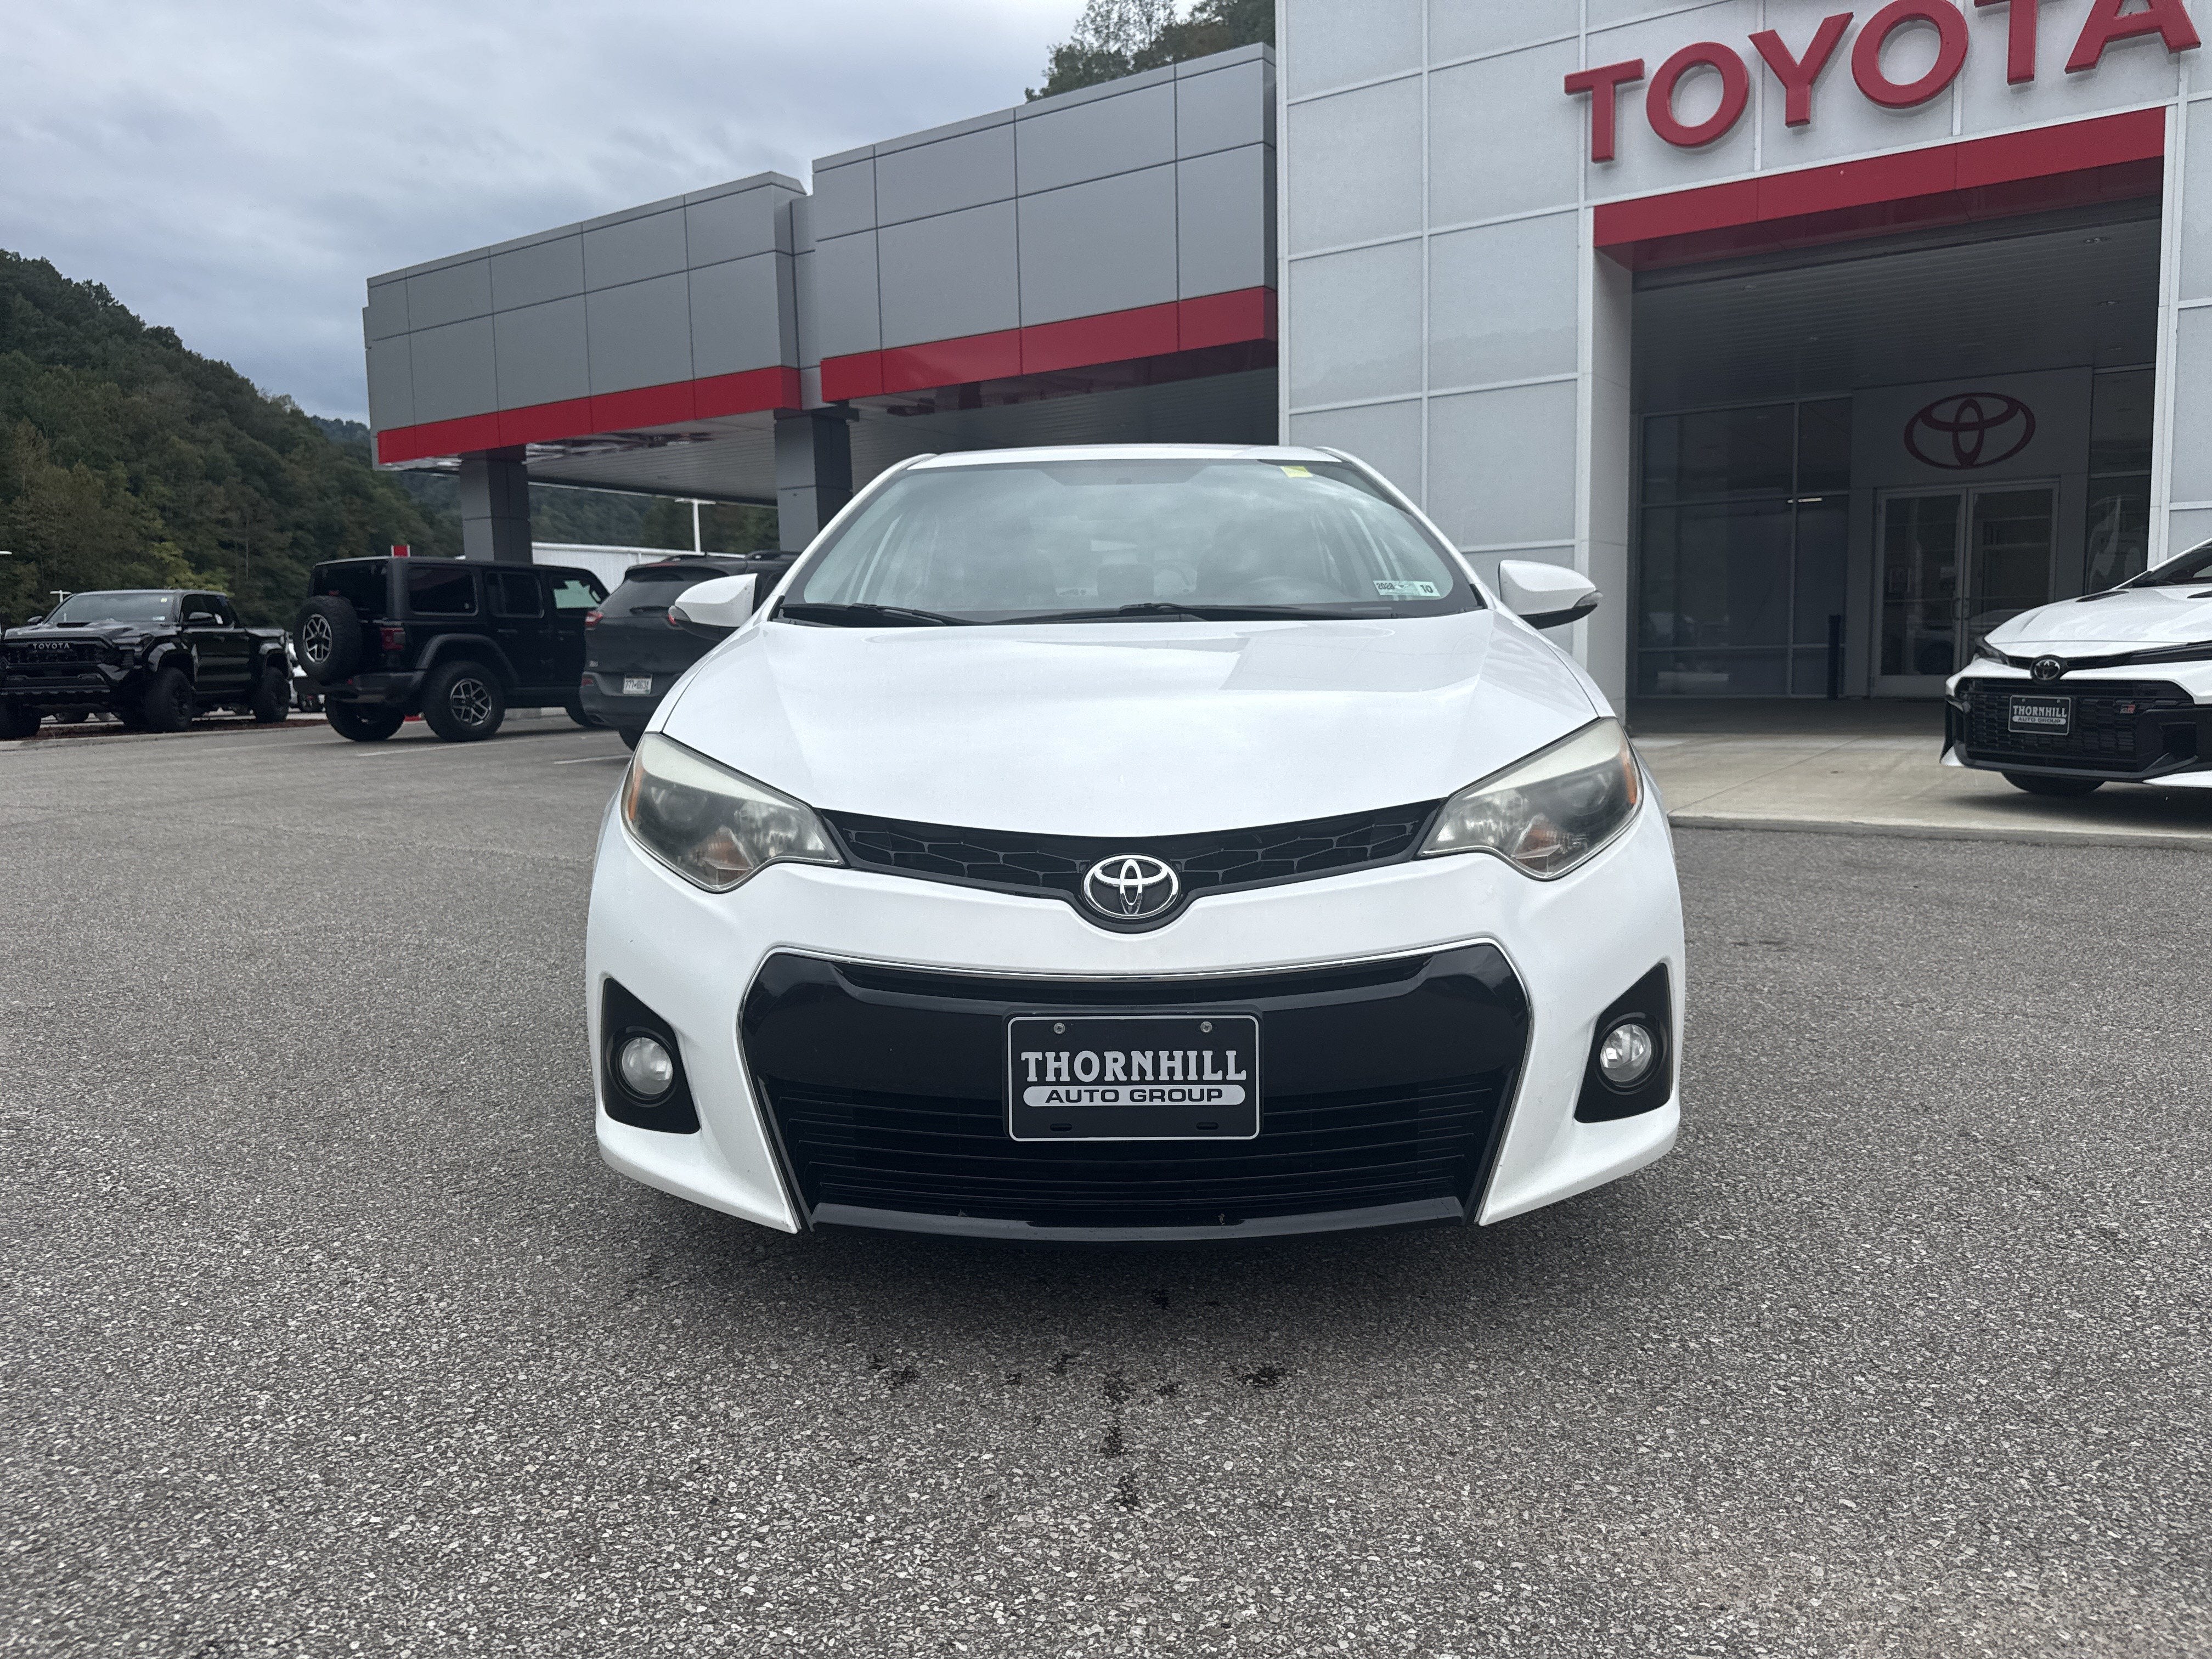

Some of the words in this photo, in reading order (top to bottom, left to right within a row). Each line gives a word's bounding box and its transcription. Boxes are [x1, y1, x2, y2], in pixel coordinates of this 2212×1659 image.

[1564, 0, 2201, 163] TOYOTA
[1420, 585, 1434, 593] 10
[2013, 705, 2067, 718] THORNHILL
[1021, 1050, 1246, 1082] THORNHILL
[1045, 1088, 1119, 1103] AUTO
[1130, 1088, 1223, 1103] GROUP
